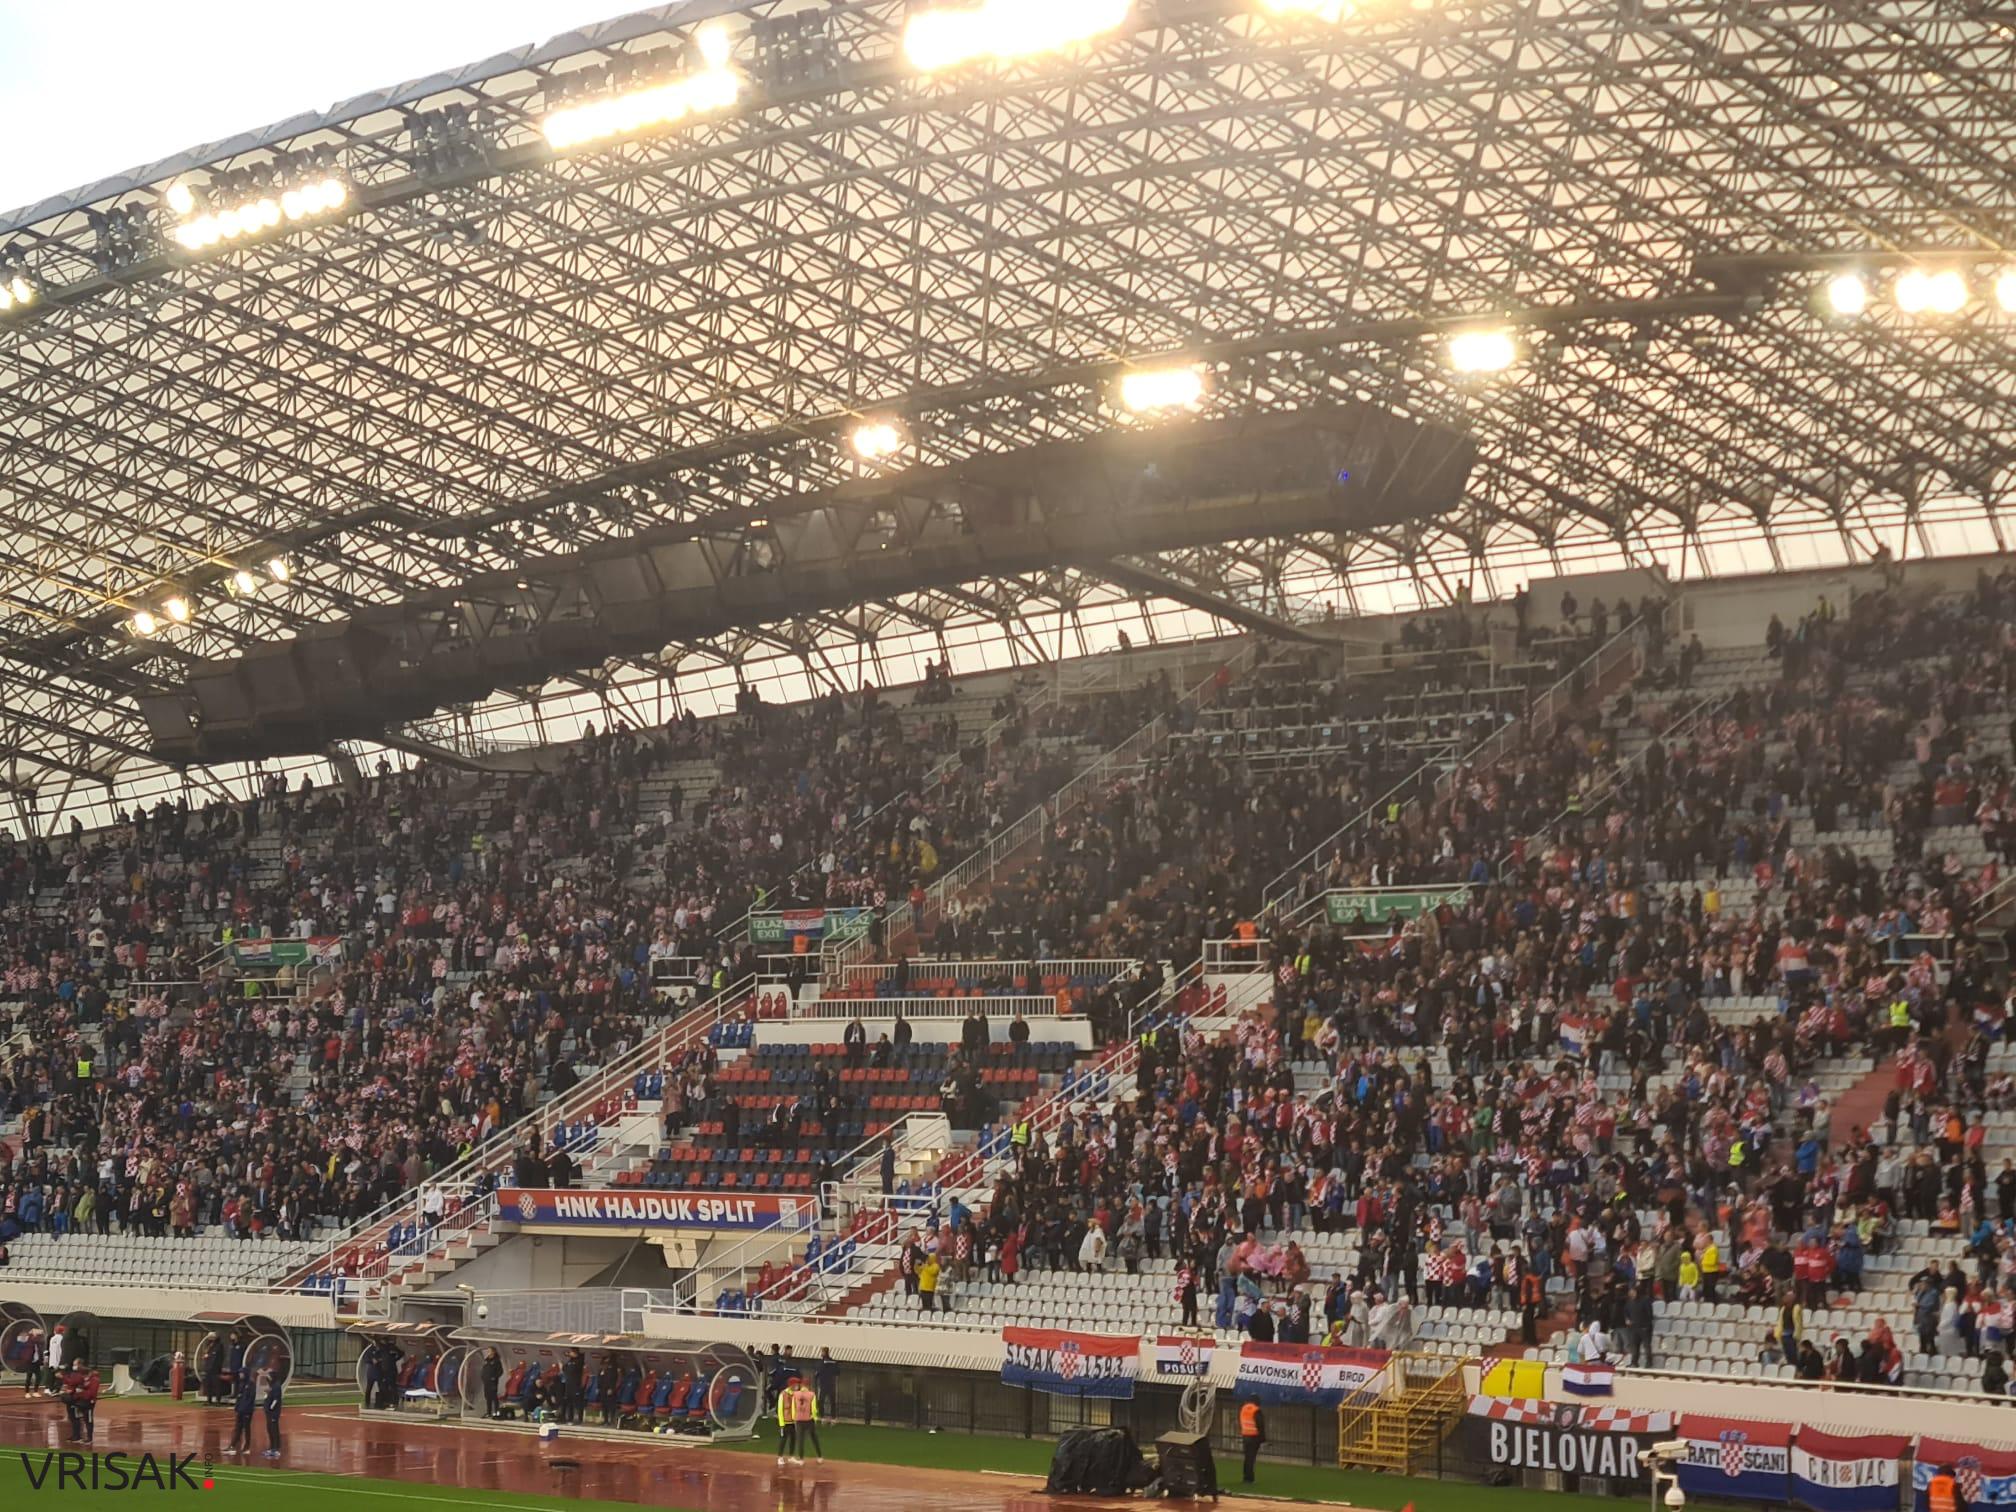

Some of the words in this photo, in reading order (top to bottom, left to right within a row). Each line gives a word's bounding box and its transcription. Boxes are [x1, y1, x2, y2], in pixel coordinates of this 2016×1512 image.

[752, 919, 784, 930] IZLAZ
[757, 930, 780, 939] EXIT
[554, 1195, 602, 1219] HNK
[604, 1197, 695, 1222] HAJDUK
[697, 1199, 756, 1223] SPLIT
[1006, 1342, 1056, 1373] SISAK
[1084, 1354, 1123, 1378] 1593
[1239, 1363, 1299, 1380] SLAVONSKI
[1338, 1370, 1366, 1383] BROD
[1489, 1422, 1640, 1479] BJELOVAR
